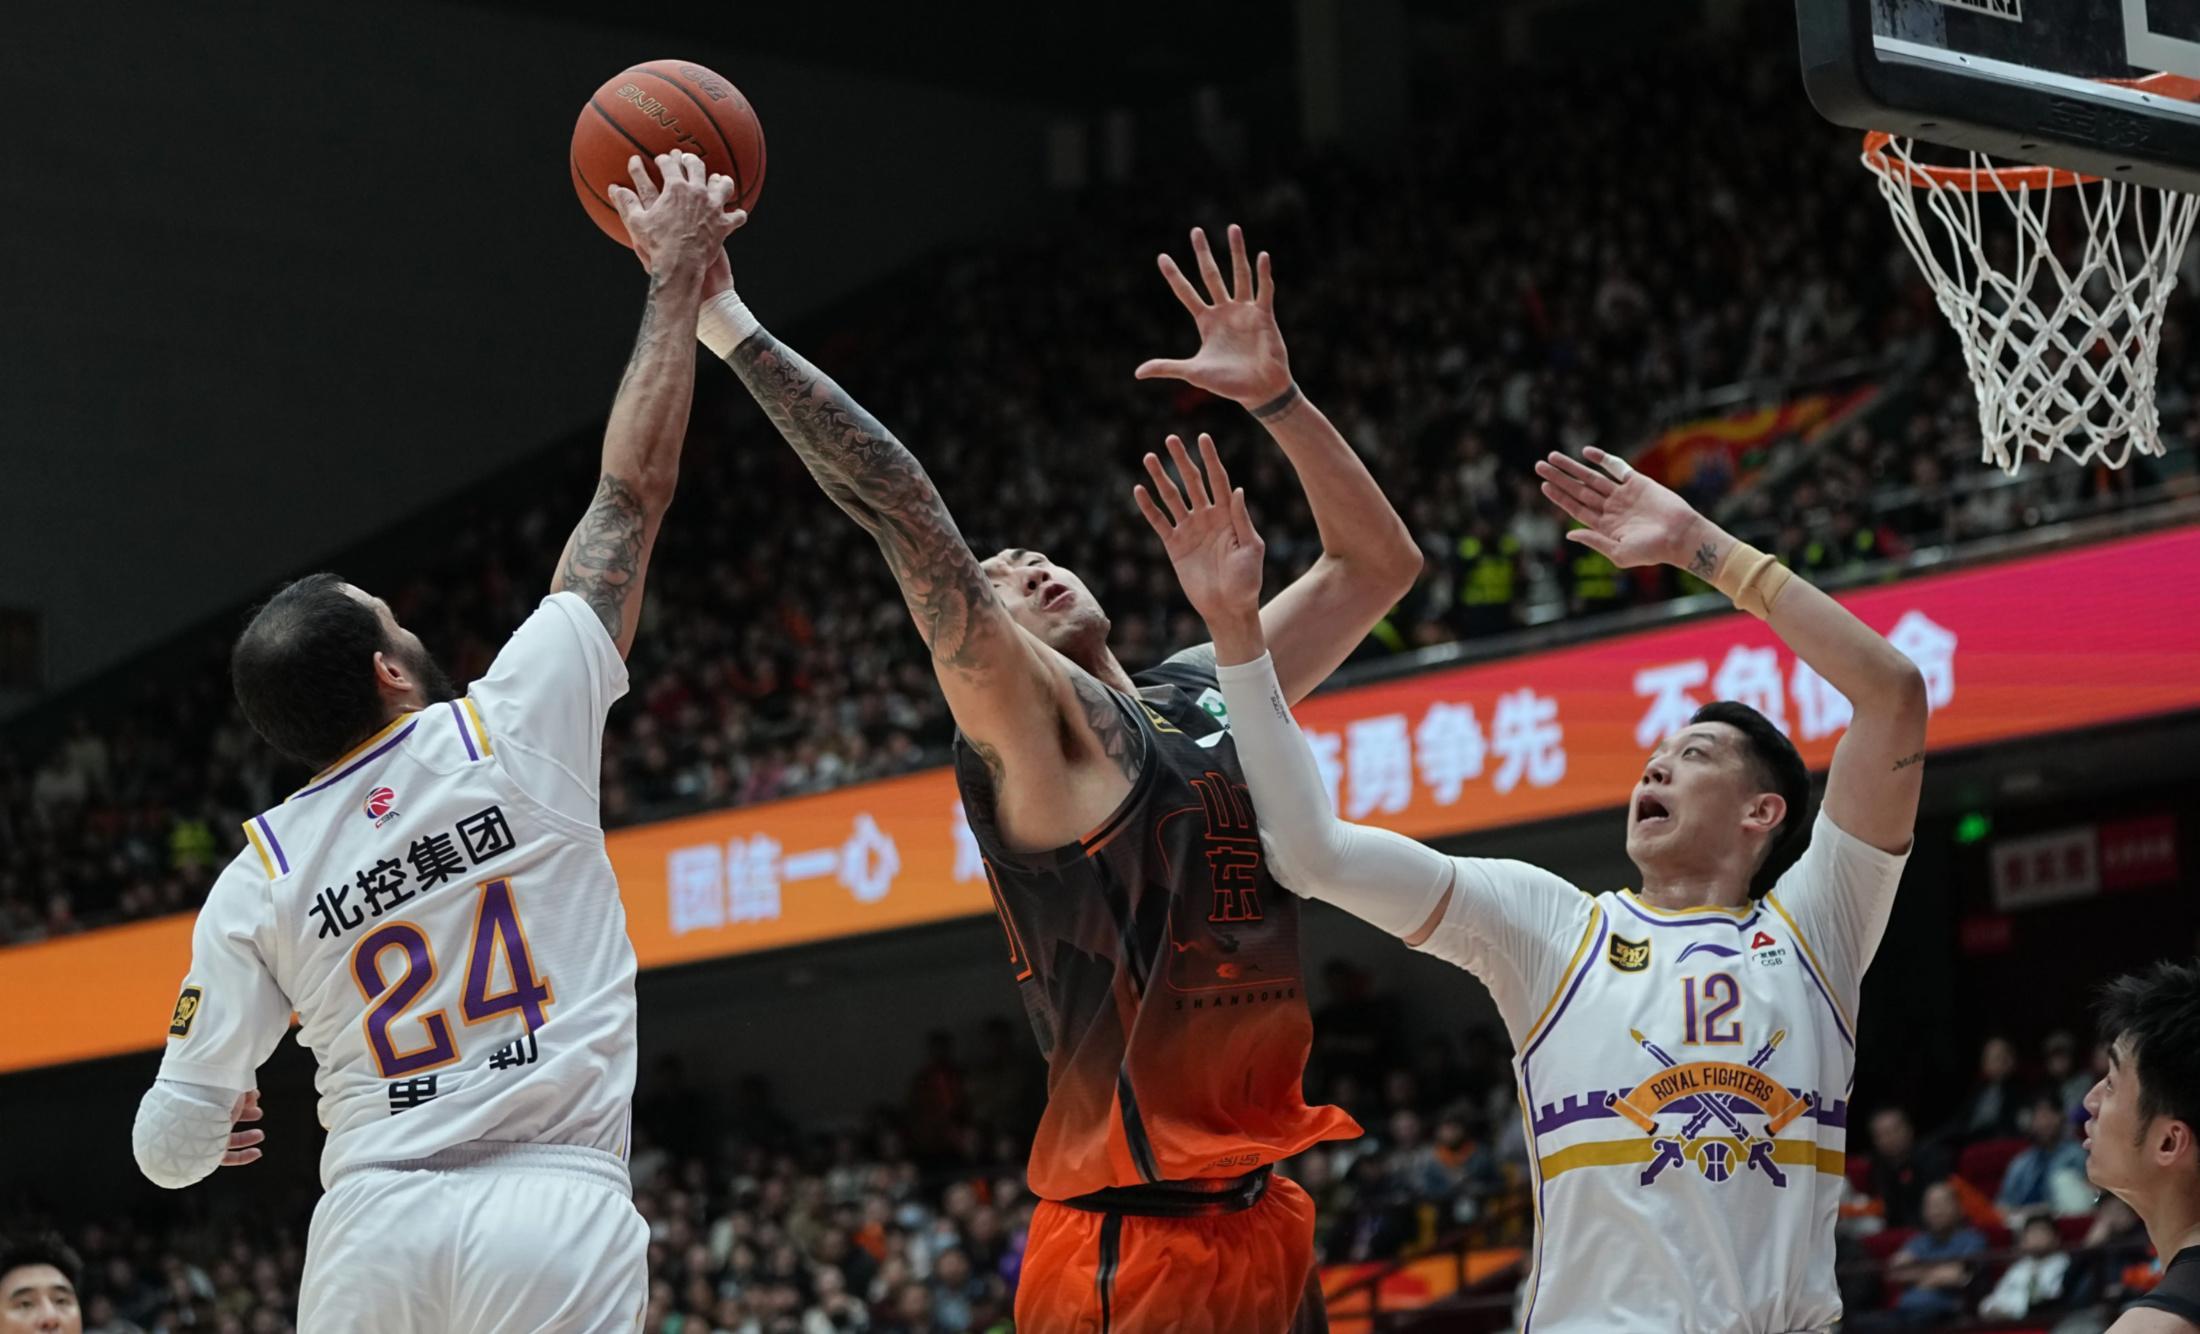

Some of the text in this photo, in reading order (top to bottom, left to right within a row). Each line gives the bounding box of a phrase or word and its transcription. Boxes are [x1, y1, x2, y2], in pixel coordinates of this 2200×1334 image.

[616, 82, 708, 159] LI-NING
[308, 805, 517, 940] 北控集团
[666, 812, 901, 935] 团结一心
[1188, 771, 1264, 922] 山东
[349, 876, 554, 1079] 24
[1174, 988, 1297, 1010] SHANDONG
[1761, 958, 1783, 967] CGB
[1680, 972, 1744, 1046] 12
[1650, 1067, 1774, 1102] ROYAL FIGHTERS
